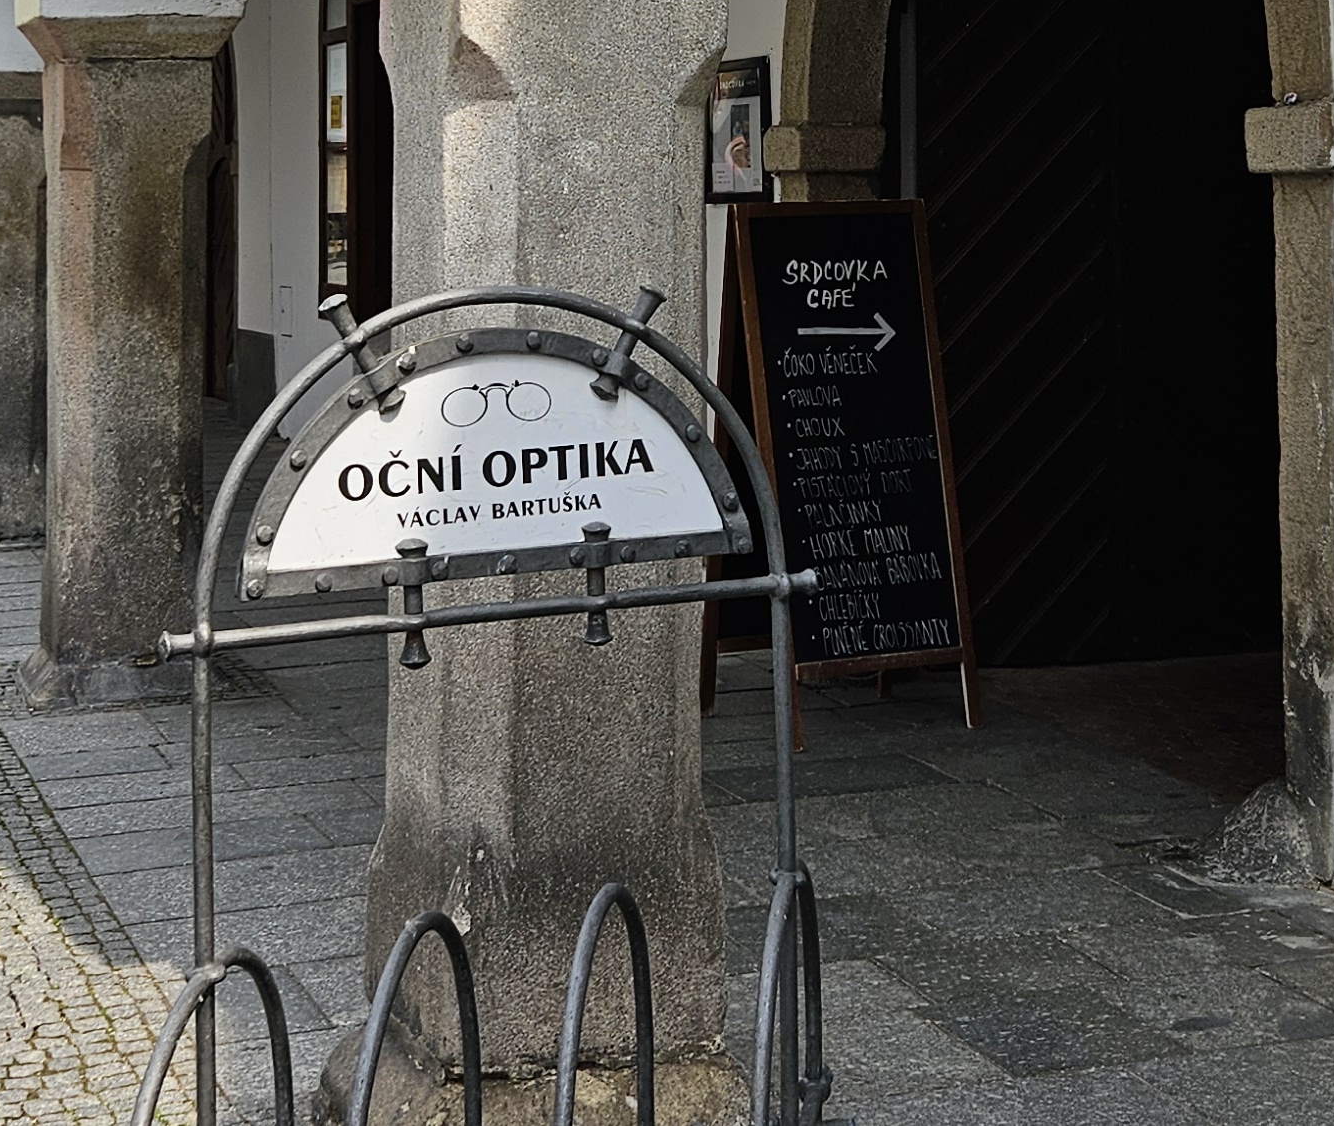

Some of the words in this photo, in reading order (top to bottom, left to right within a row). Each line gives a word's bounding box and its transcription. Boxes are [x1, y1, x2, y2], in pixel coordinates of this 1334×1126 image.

[781, 258, 889, 285] SRDCOVKA
[806, 282, 857, 310] CAFÉ
[783, 347, 816, 377] ČOKO
[818, 344, 878, 375] VĚNEČEK
[788, 385, 843, 408] PAVLOVA
[794, 416, 846, 438] CHOUX
[337, 443, 463, 502] OČNÍ
[481, 438, 655, 488] OPTIKA
[796, 445, 843, 472] JAHODY
[849, 443, 859, 467] S
[880, 468, 912, 494] DORT
[396, 504, 482, 529] VÁCLAV
[491, 491, 603, 520] BARTUŠKA
[804, 498, 883, 529] PALAČINKY
[809, 525, 860, 561] HORKÉ
[863, 524, 912, 555] MALINY
[884, 551, 943, 586] BÁBOVKA
[872, 617, 951, 651] CROISSANTY
